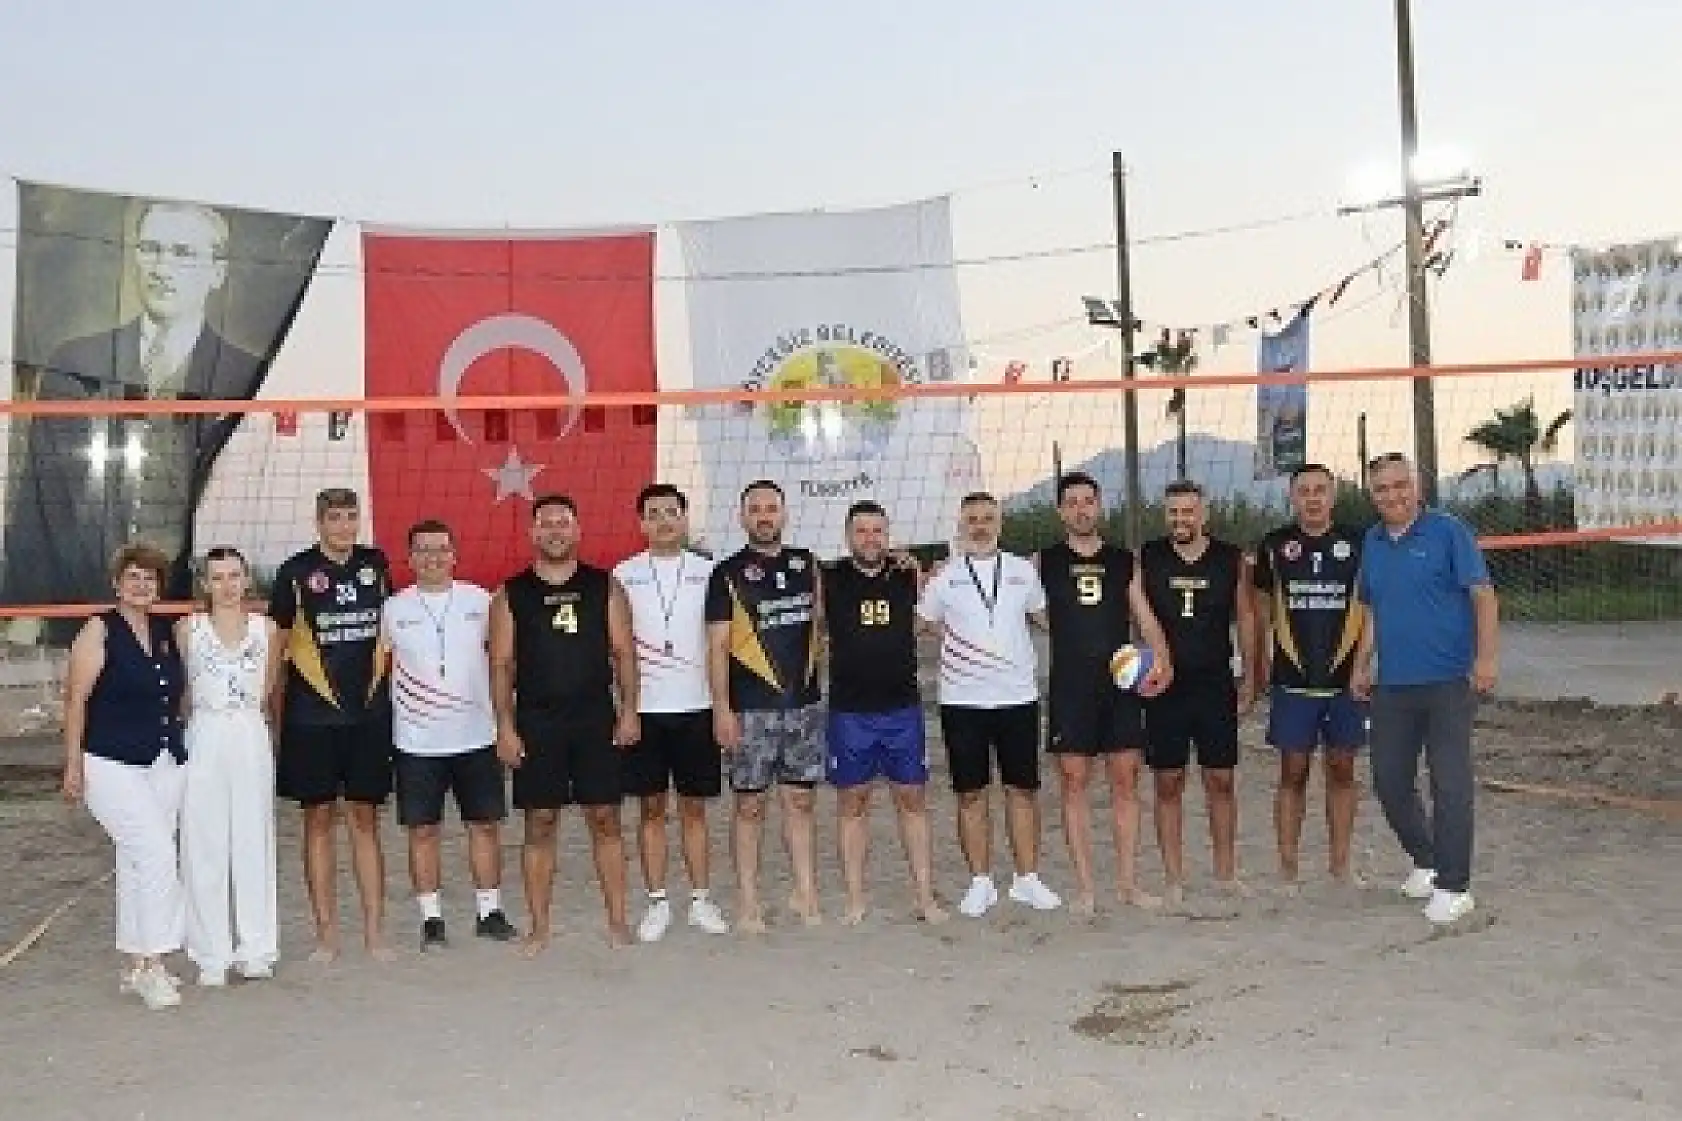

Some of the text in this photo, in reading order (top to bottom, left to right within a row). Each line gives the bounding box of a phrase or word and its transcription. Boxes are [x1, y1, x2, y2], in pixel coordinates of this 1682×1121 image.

[1076, 576, 1102, 605] 9
[551, 604, 578, 633] 4
[860, 599, 890, 625] 99
